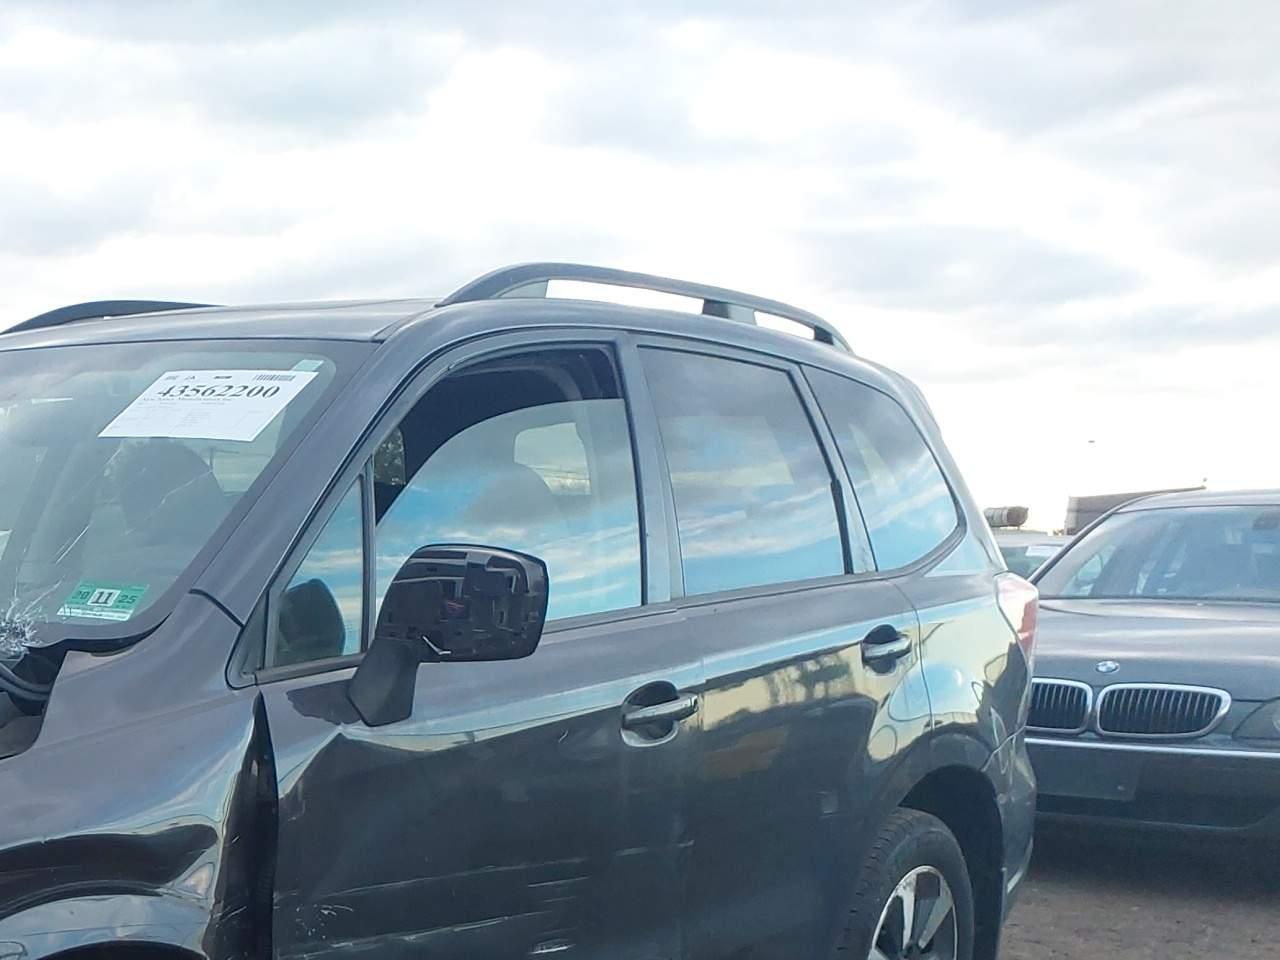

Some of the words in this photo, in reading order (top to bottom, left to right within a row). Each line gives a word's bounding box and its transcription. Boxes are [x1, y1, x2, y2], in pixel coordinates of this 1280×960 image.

[156, 384, 280, 399] 43562200
[91, 591, 114, 605] 11
[118, 594, 137, 604] 25
